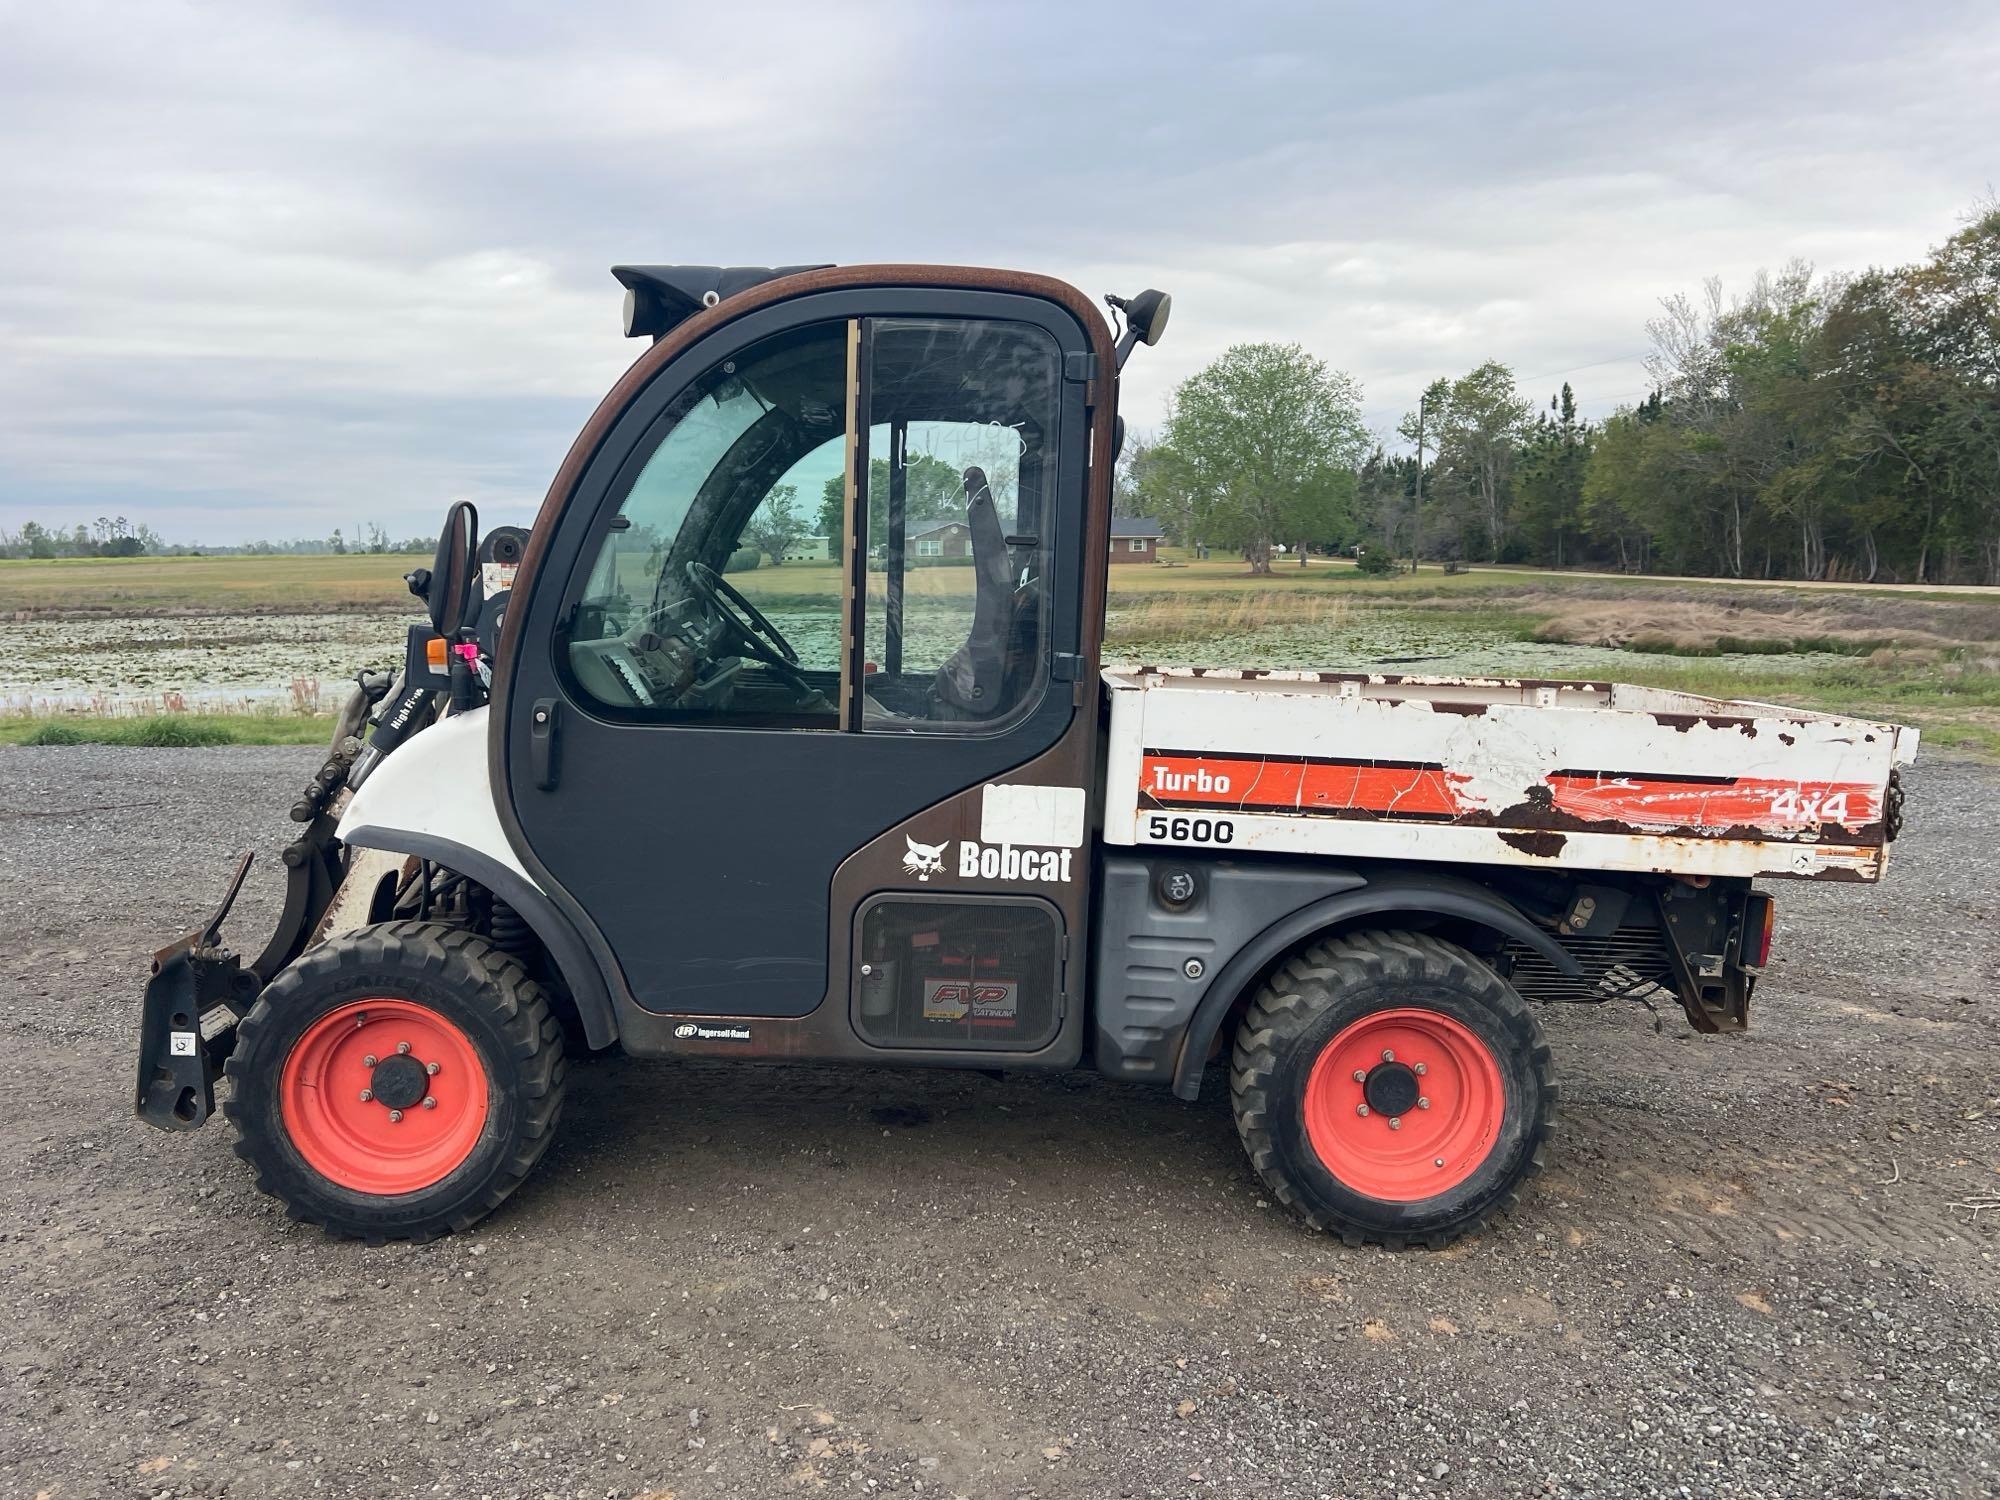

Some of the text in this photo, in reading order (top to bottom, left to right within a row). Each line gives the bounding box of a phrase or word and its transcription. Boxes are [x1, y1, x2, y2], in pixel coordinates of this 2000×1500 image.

[390, 708, 410, 730] High
[1153, 766, 1231, 794] Turbo
[1770, 790, 1848, 824] 4x4
[1149, 816, 1234, 844] 5600
[958, 840, 1072, 882] Bobcat
[932, 984, 1008, 1005] FVP
[972, 1008, 1013, 1017] LATINUM
[698, 1028, 751, 1039] Ingersoll-Rand
